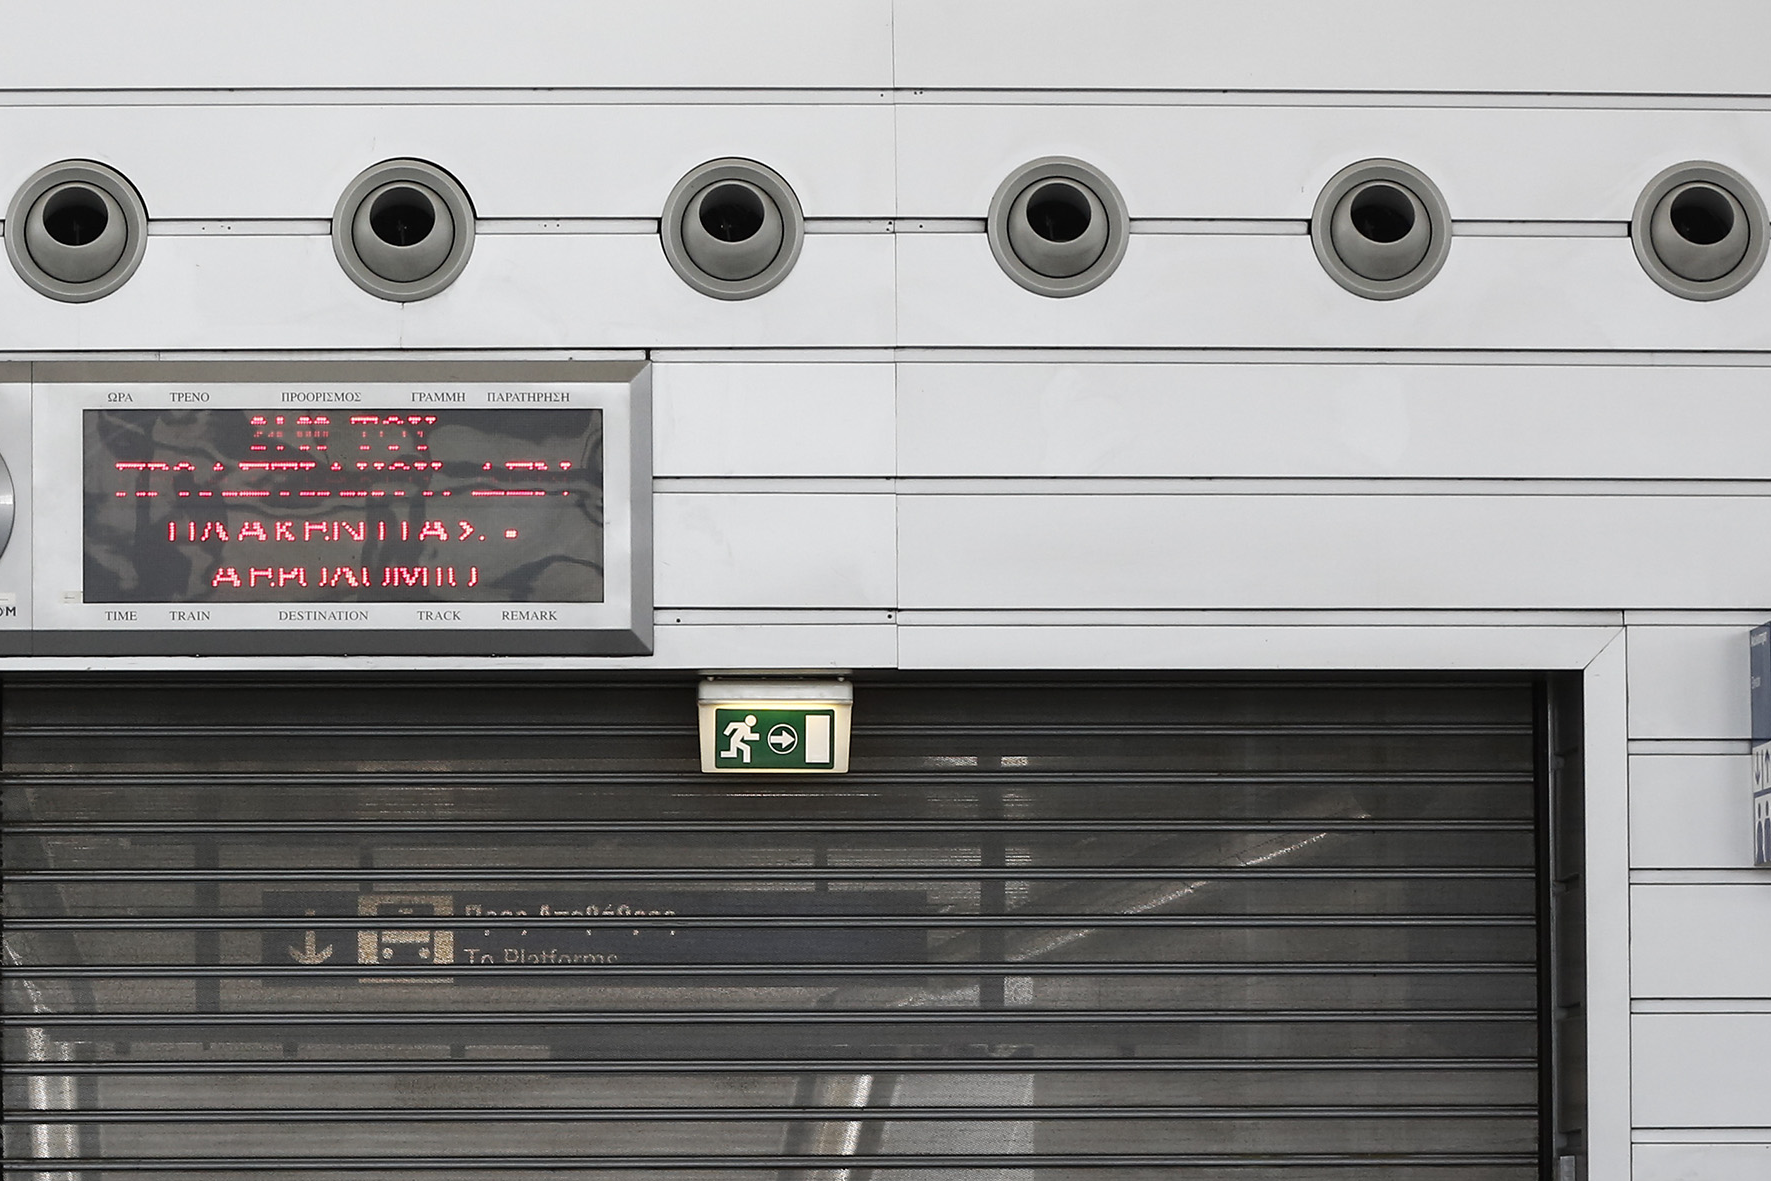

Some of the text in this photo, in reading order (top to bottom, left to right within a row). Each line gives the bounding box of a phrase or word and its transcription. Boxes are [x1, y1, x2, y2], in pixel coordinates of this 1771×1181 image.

[107, 392, 570, 403] ΩΡΑ ΤΡΕΝΟ ΠΡΟΟΡΙΣΜΟΣ ΓΡΑΜΜΗ ΠΑΡΑΤΗΡΗΣΗ
[104, 610, 558, 621] TIME TRAIN DESTINATION TRACK REMARK
